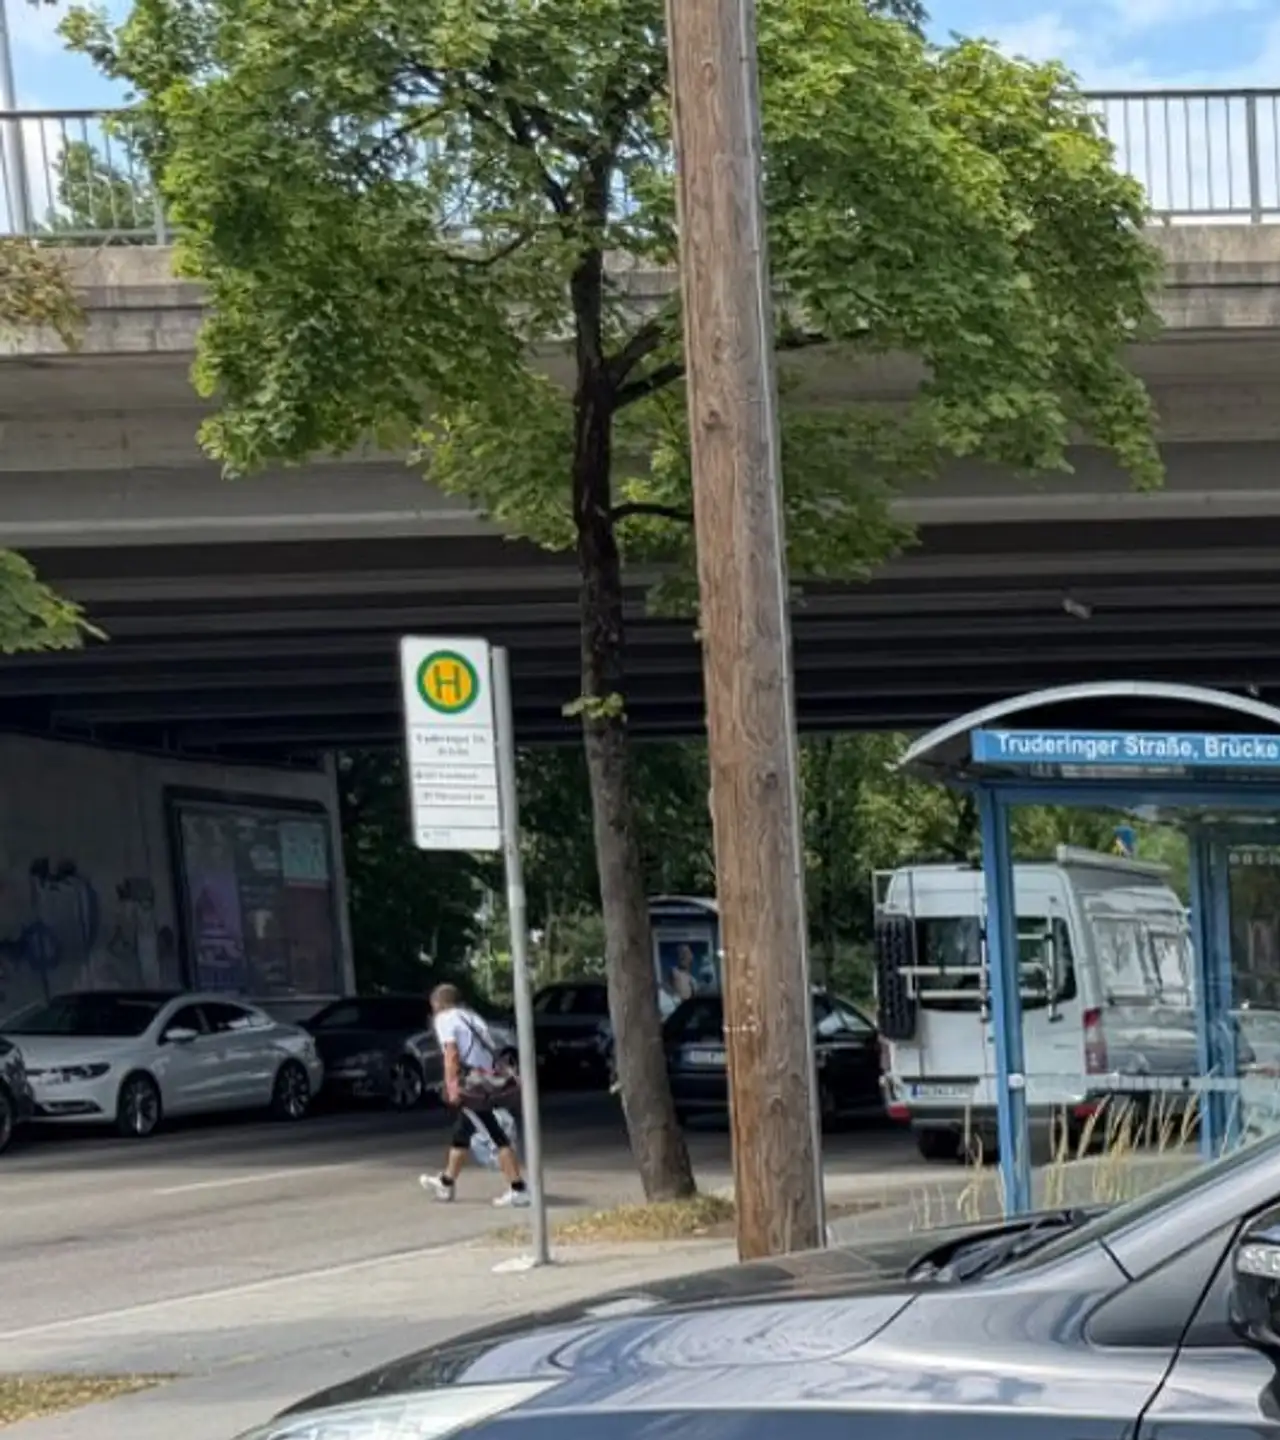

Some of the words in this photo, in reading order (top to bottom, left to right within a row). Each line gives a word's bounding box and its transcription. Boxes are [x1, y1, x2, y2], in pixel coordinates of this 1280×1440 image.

[997, 732, 1119, 761] Truderinger
[1124, 734, 1200, 760] Straße,
[1203, 735, 1280, 759] Brücke
